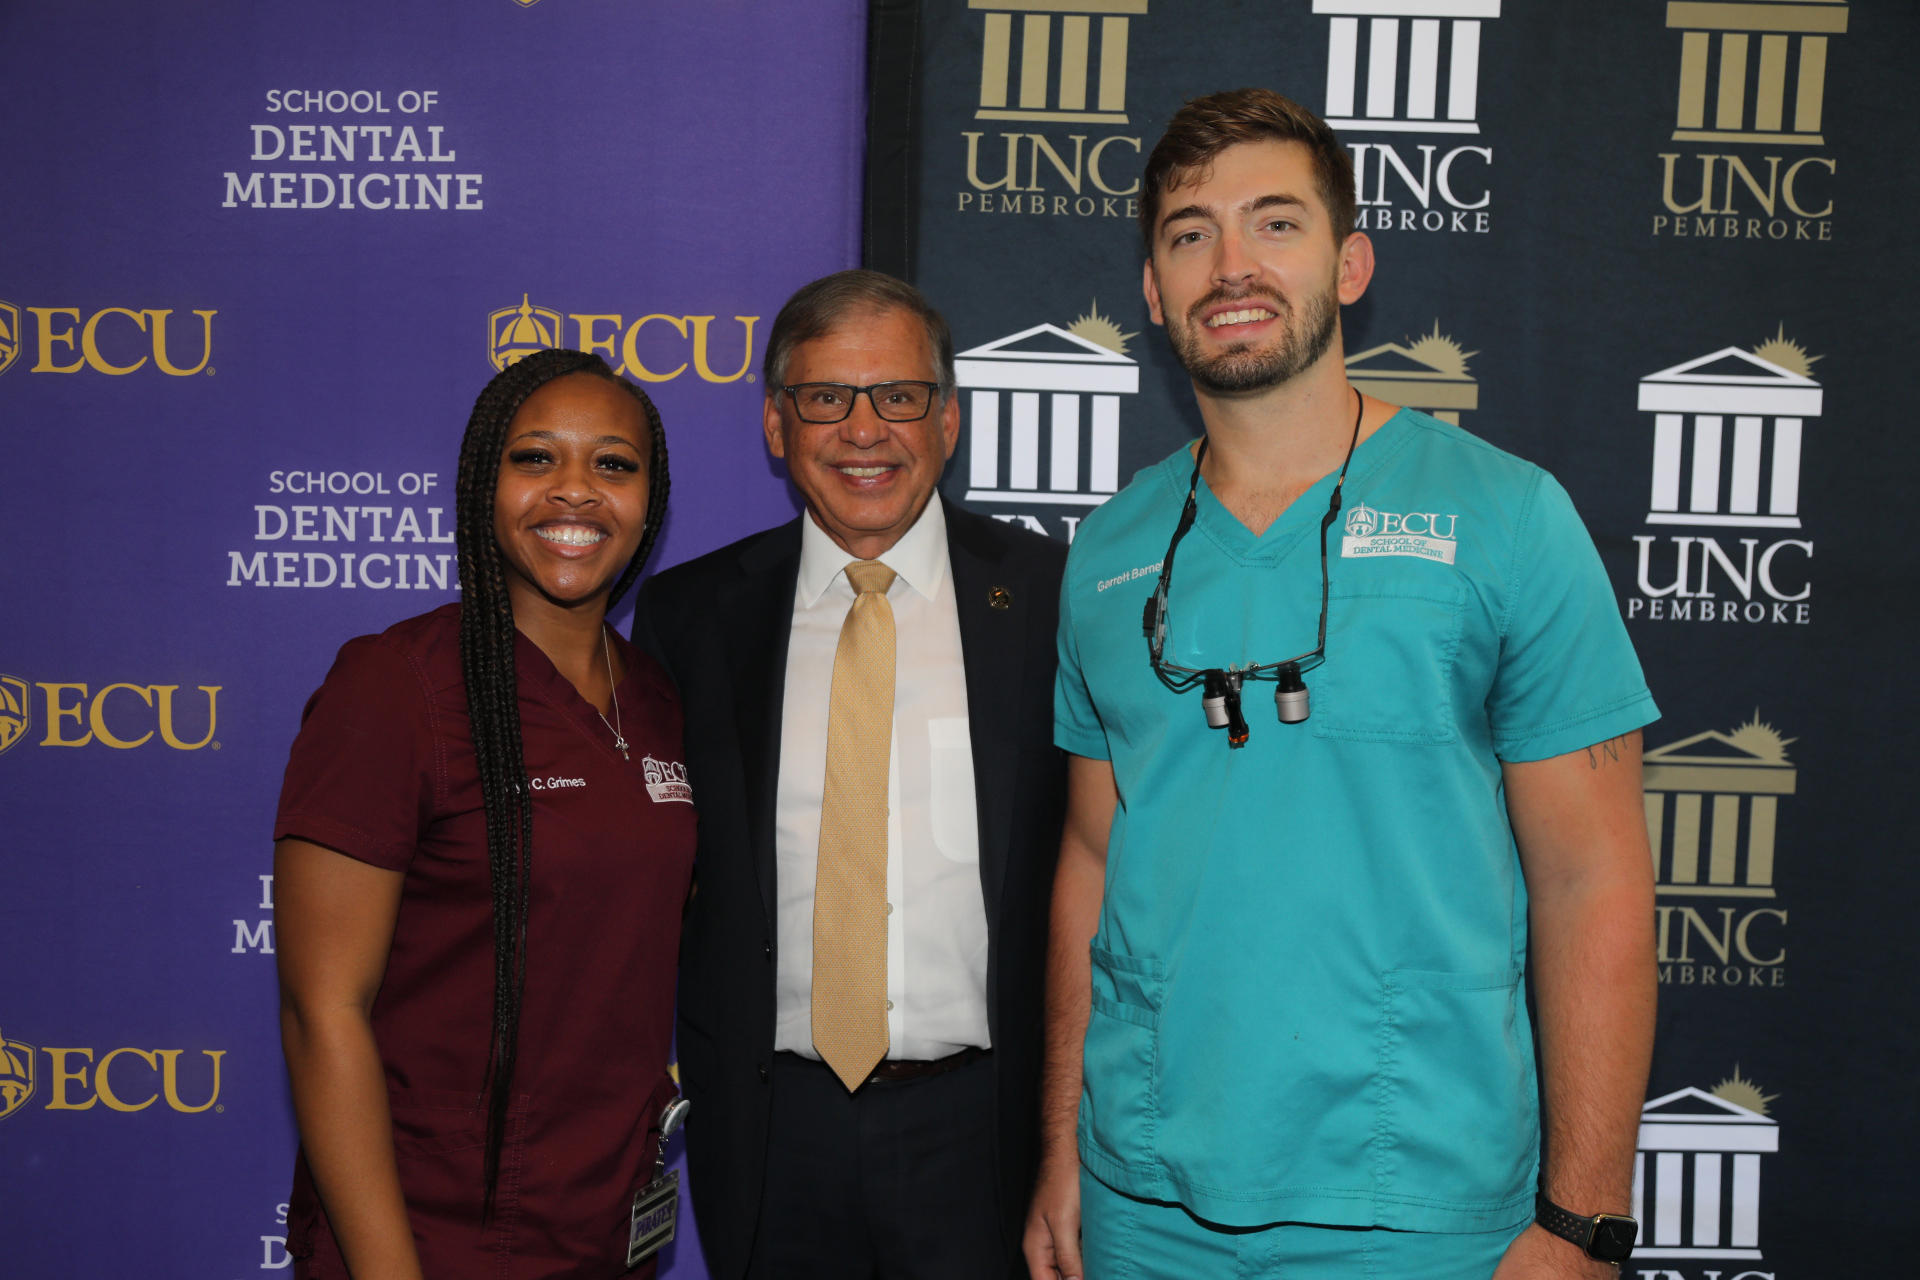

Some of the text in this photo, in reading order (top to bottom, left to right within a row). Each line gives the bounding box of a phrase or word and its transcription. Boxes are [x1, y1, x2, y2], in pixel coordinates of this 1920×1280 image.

[266, 89, 438, 113] SCHOOL OF
[251, 124, 455, 162] DENTAL
[961, 132, 1142, 196] UNC
[222, 172, 484, 210] MEDICINE
[1658, 153, 1836, 218] UNC
[958, 192, 1141, 218] PEMBROKE
[1354, 208, 1490, 233] MBROKE
[1652, 215, 1832, 241] PEMBROKE
[27, 307, 218, 377] ECU
[568, 313, 760, 384] ECU
[269, 470, 438, 495] SCHOOL OF
[254, 505, 455, 543] DENTAL
[1378, 512, 1459, 539] ECU
[1353, 545, 1444, 559] DENTAL MEDICINE
[1370, 538, 1412, 546] SCHOOL
[1097, 571, 1131, 592] Garrett
[1632, 535, 1814, 601] UNC
[1627, 598, 1811, 625] PEMBROKE
[35, 682, 223, 750] ECU
[531, 778, 546, 790] C.
[547, 776, 587, 789] Grimes
[1658, 965, 1786, 987] MBROKE
[41, 1047, 227, 1113] ECU
[634, 1203, 673, 1242] PIRATES
